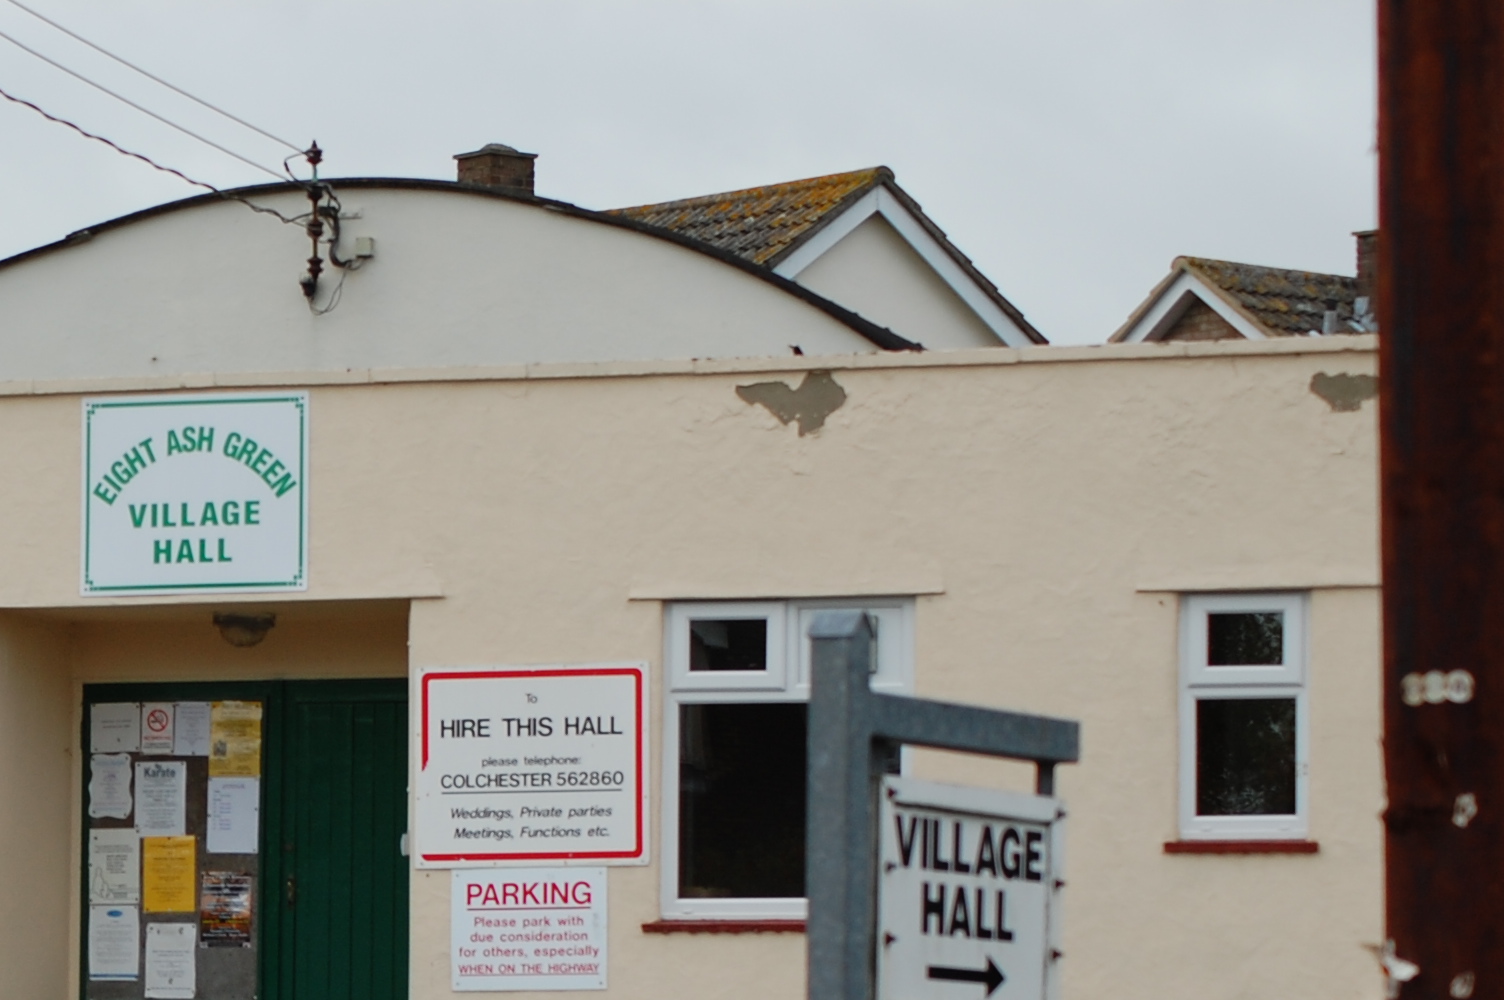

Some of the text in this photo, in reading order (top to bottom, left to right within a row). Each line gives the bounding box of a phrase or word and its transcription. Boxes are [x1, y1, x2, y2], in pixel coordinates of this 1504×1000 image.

[93, 426, 297, 506] EIGHT ASH GREEN
[128, 500, 260, 528] VILLAGE
[153, 538, 233, 564] HALL
[525, 693, 538, 704] To
[440, 716, 623, 738] HIRE THIS HALL
[481, 755, 582, 768] please telephone:
[143, 766, 176, 778] Karate
[440, 770, 624, 789] COLCHESTER 562860
[450, 805, 612, 821] Weddings, Private parties
[453, 826, 610, 841] Meetings, Functions etc.
[896, 814, 1042, 881] VILLAGE
[466, 881, 592, 906] PARKING
[921, 882, 1014, 942] HALL
[474, 916, 584, 929] Please park with
[470, 931, 588, 943] due consideration
[458, 946, 599, 959] for others, especially
[458, 963, 599, 975] WHEN ON THE HIGHWAY
